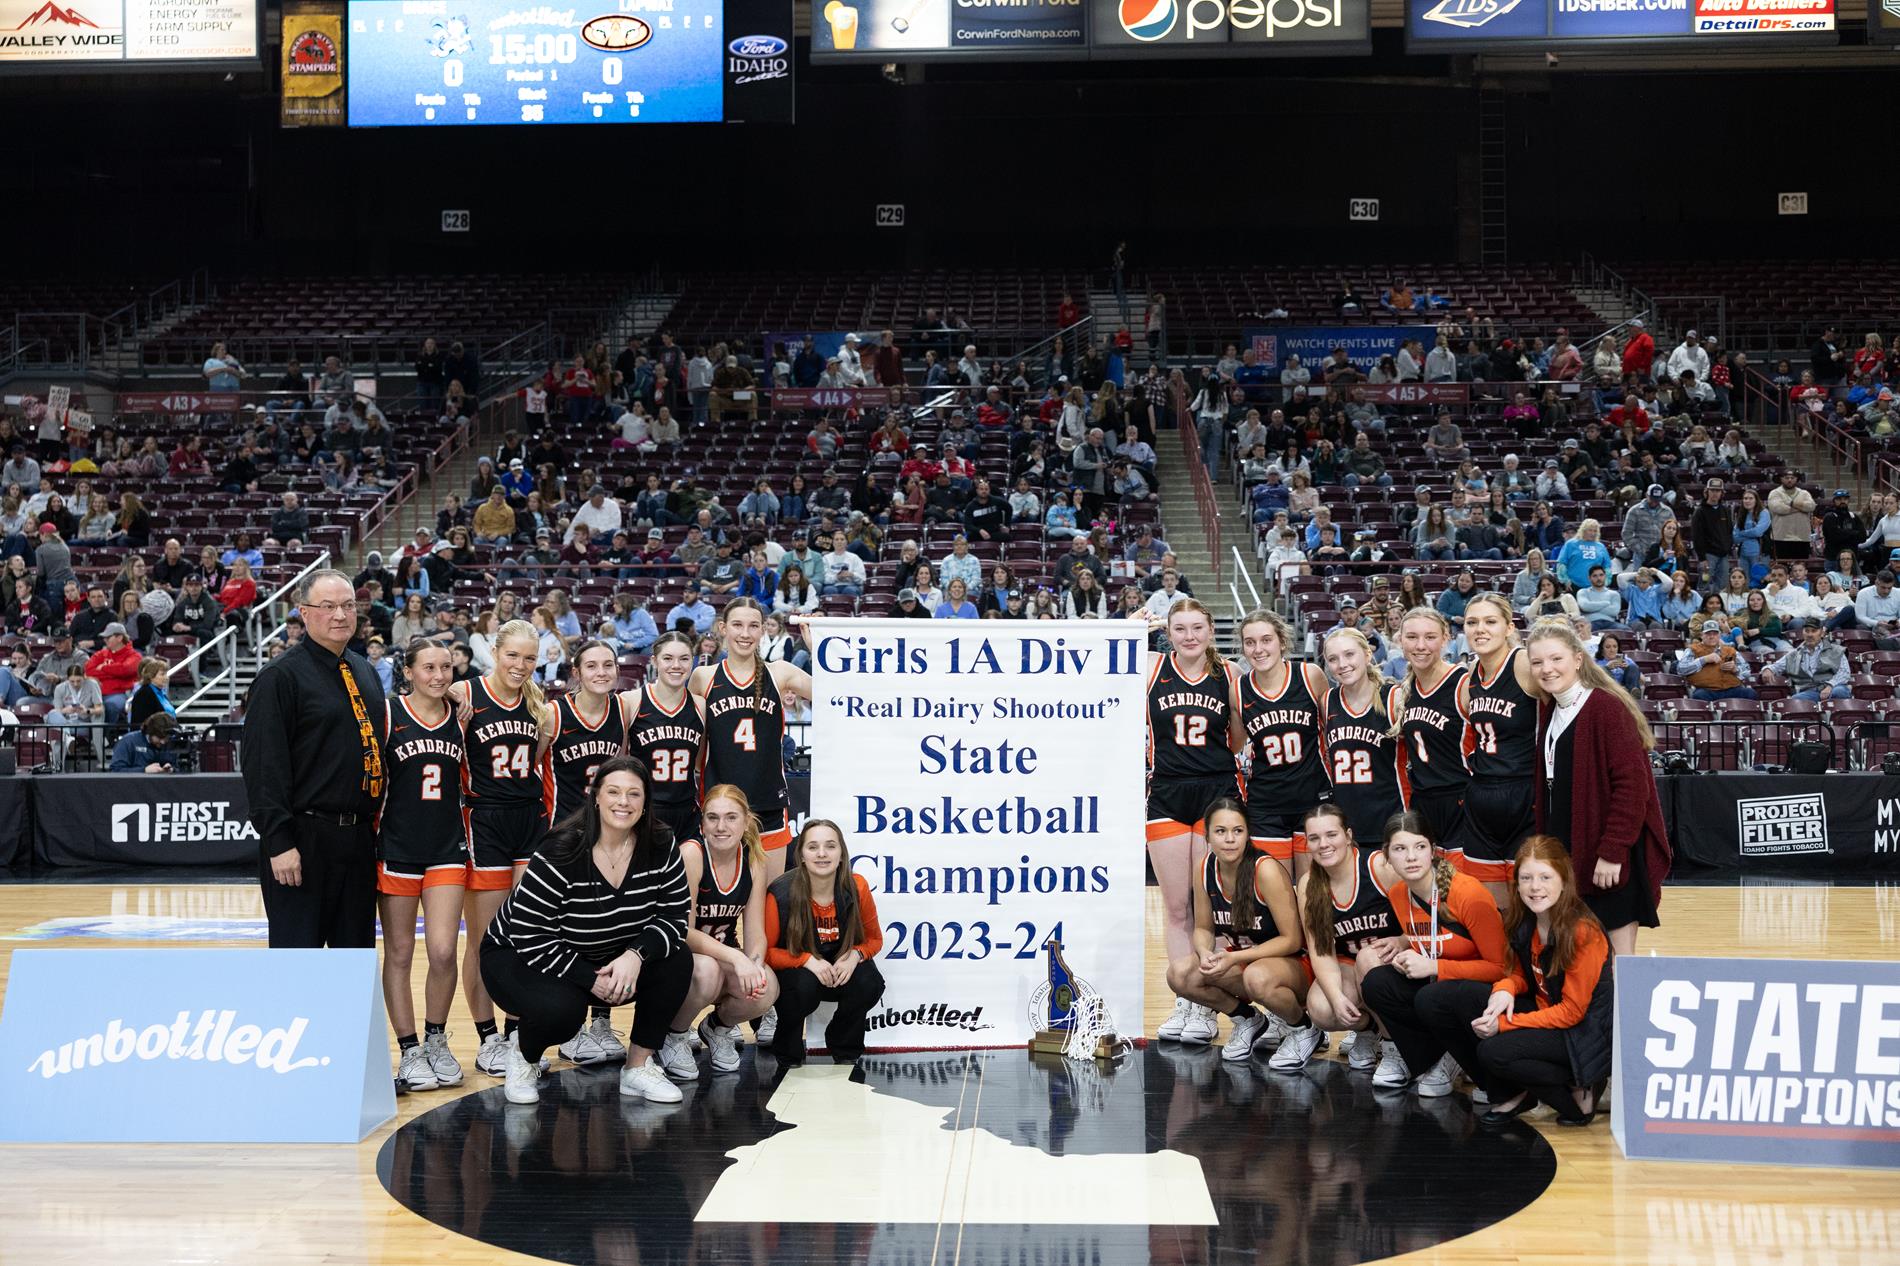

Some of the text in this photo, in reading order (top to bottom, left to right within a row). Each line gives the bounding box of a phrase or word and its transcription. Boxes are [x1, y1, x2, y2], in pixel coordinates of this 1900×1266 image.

[149, 9, 198, 19] ENERGY
[1187, 0, 1342, 39] pepsi
[1700, 18, 1826, 30] DetailDrs.com
[149, 21, 233, 31] FARM SUPPLY
[957, 29, 1080, 39] CorwinFordNampa.com
[72, 35, 122, 45] WIDE
[149, 35, 179, 45] FEED
[488, 33, 577, 64] 15:00
[740, 40, 776, 54] Ford
[289, 64, 336, 72] STAMPEDE
[444, 59, 463, 86] 0
[603, 57, 622, 85] 0
[729, 57, 788, 72] IDAHO
[878, 207, 903, 223] C29
[1352, 201, 1377, 217] C30
[1781, 195, 1805, 212] C31
[444, 213, 468, 228] C28
[1285, 338, 1395, 349] WATCH EVENTS LIVE
[173, 397, 188, 410] A3
[824, 392, 838, 406] A4
[1401, 386, 1414, 400] A5
[1582, 551, 1597, 560] 23
[817, 636, 1142, 675] Girls 1A Div II
[709, 696, 776, 717] KENDRCK
[912, 697, 984, 724] Dairy
[1157, 692, 1225, 715] KENDRICK
[1469, 696, 1516, 718] ENDRICK
[1174, 714, 1208, 746] 12
[1246, 709, 1312, 736] KENDRICK
[637, 726, 702, 747] KENDRICK
[734, 718, 756, 751] 4
[1475, 722, 1497, 755] 11
[395, 739, 464, 762] KENDRICK
[920, 734, 1037, 774] State
[1263, 732, 1302, 766] 20
[1413, 731, 1429, 763] 1
[491, 744, 530, 779] 24
[652, 749, 690, 782] 32
[1334, 750, 1373, 784] 22
[422, 763, 441, 800] 2
[156, 801, 230, 821] FIRST
[853, 796, 1100, 834] Basketball
[1742, 802, 1820, 821] PROJECT
[1878, 798, 1900, 826] M
[154, 820, 261, 842] FEDERA
[1743, 820, 1823, 843] FILTER
[1792, 842, 1824, 851] TOBACCO
[850, 855, 1110, 905] Champions
[696, 904, 745, 918] ENDRIC
[1334, 912, 1388, 938] NDRICK
[885, 921, 1065, 960] 2023-24
[1644, 979, 1900, 1076] STATE
[1644, 1072, 1900, 1128] CHAMPIONS
